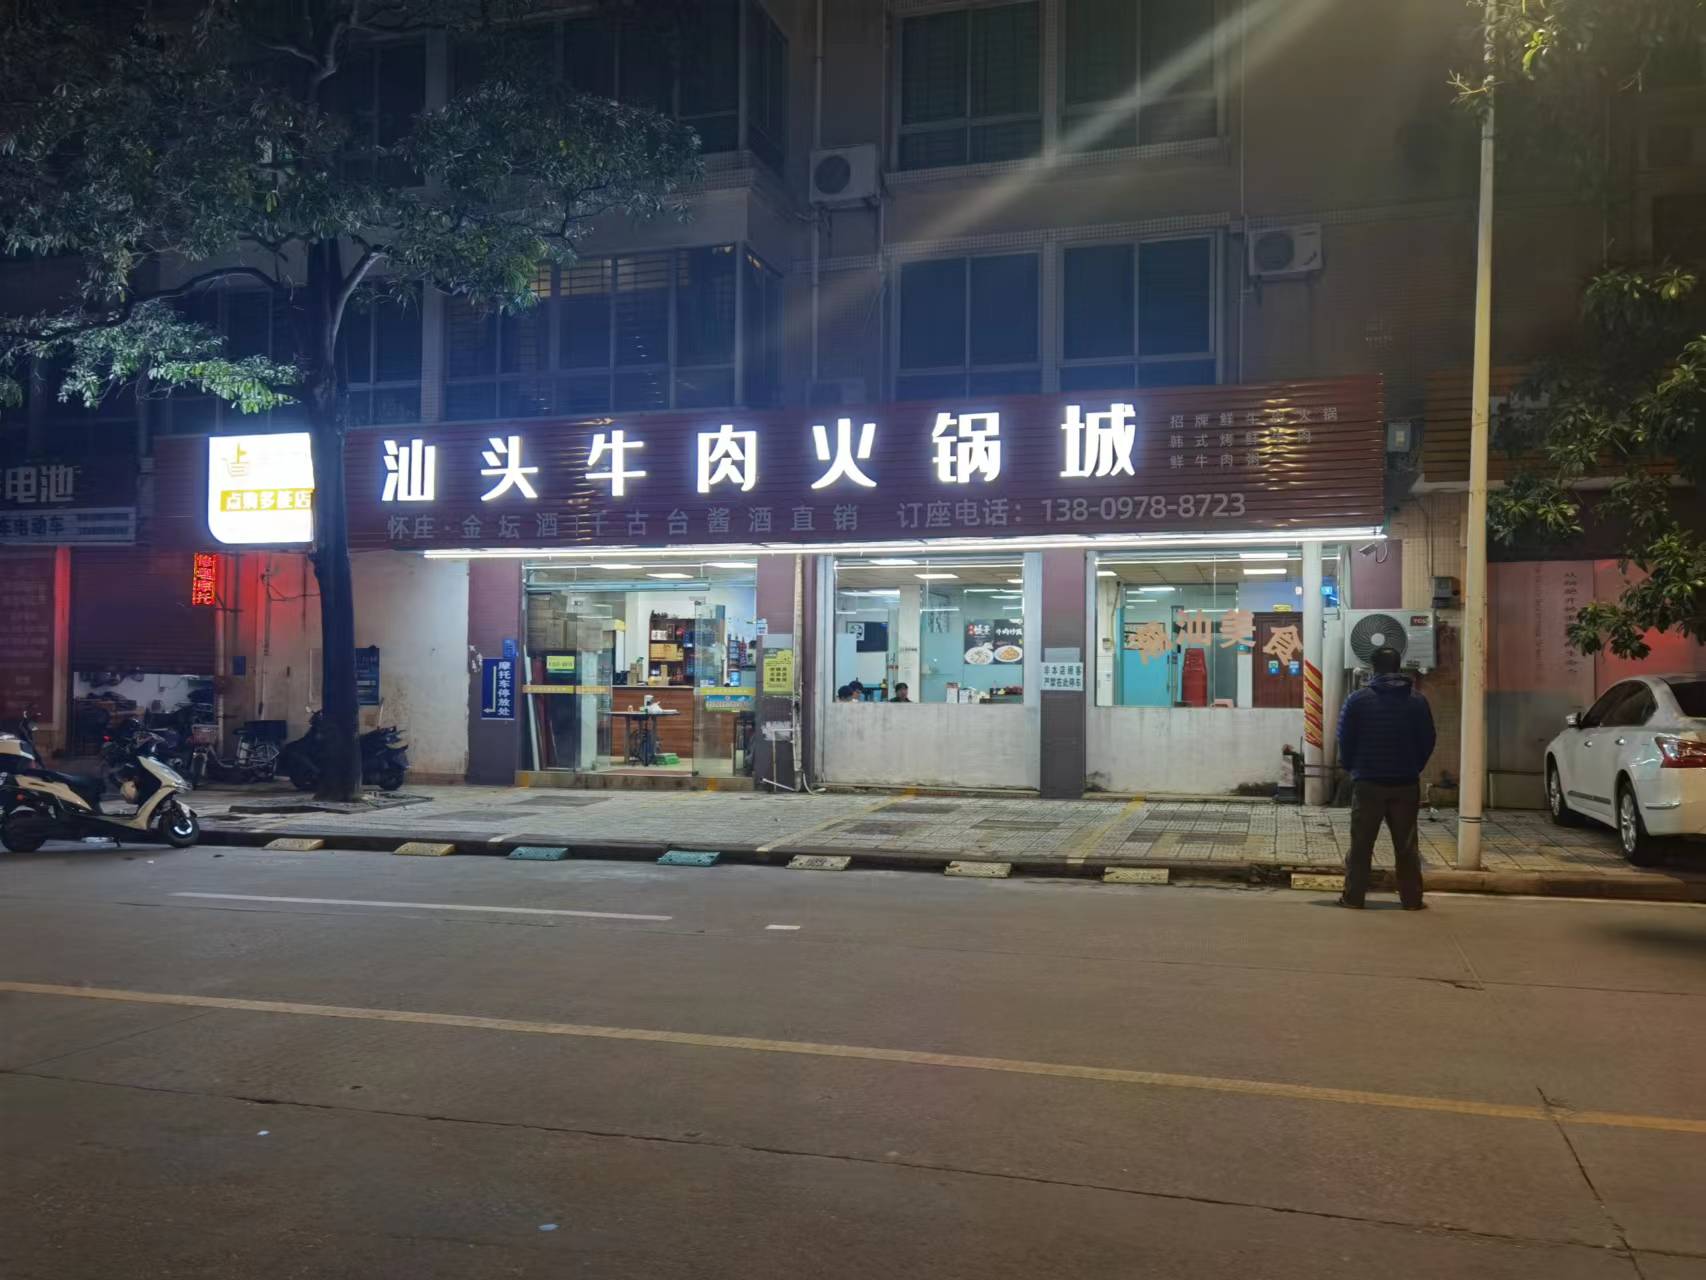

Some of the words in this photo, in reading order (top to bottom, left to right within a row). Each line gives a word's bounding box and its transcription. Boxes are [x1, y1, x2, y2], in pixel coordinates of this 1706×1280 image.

[381, 402, 1137, 503] 汕头牛肉火锅城
[0, 464, 76, 504] 电池
[497, 661, 512, 716] 摩托车停放处
